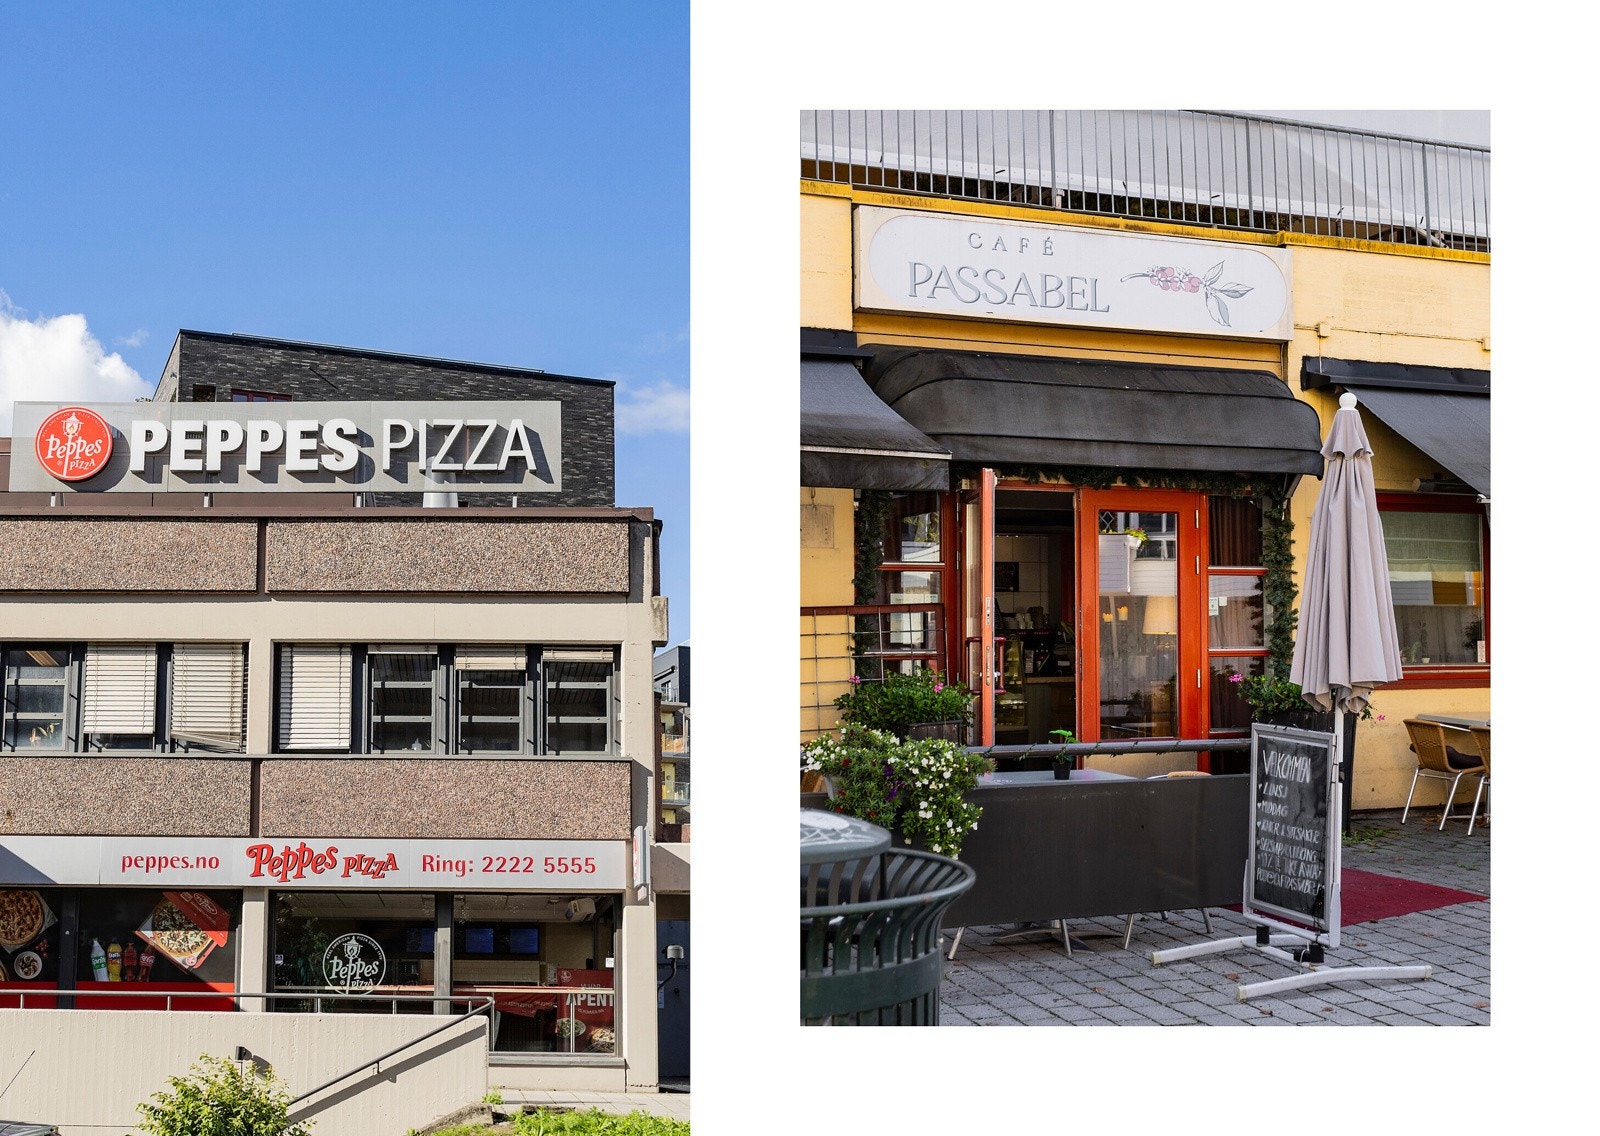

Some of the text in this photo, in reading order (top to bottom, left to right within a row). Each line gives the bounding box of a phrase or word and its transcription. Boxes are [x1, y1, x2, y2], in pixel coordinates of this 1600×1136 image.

[968, 231, 1055, 257] CAFÉ
[907, 260, 1110, 313] PASSABEL
[45, 434, 103, 460] Peppes
[130, 418, 537, 473] PEPPES PIZZA
[69, 458, 95, 471] PIZZA
[1262, 801, 1288, 817] MIDDAG
[122, 855, 220, 873] peppes.no
[246, 842, 399, 883] Peppes PIZZA
[422, 854, 596, 877] Ring: 2222 5555
[329, 956, 380, 980] Peppes
